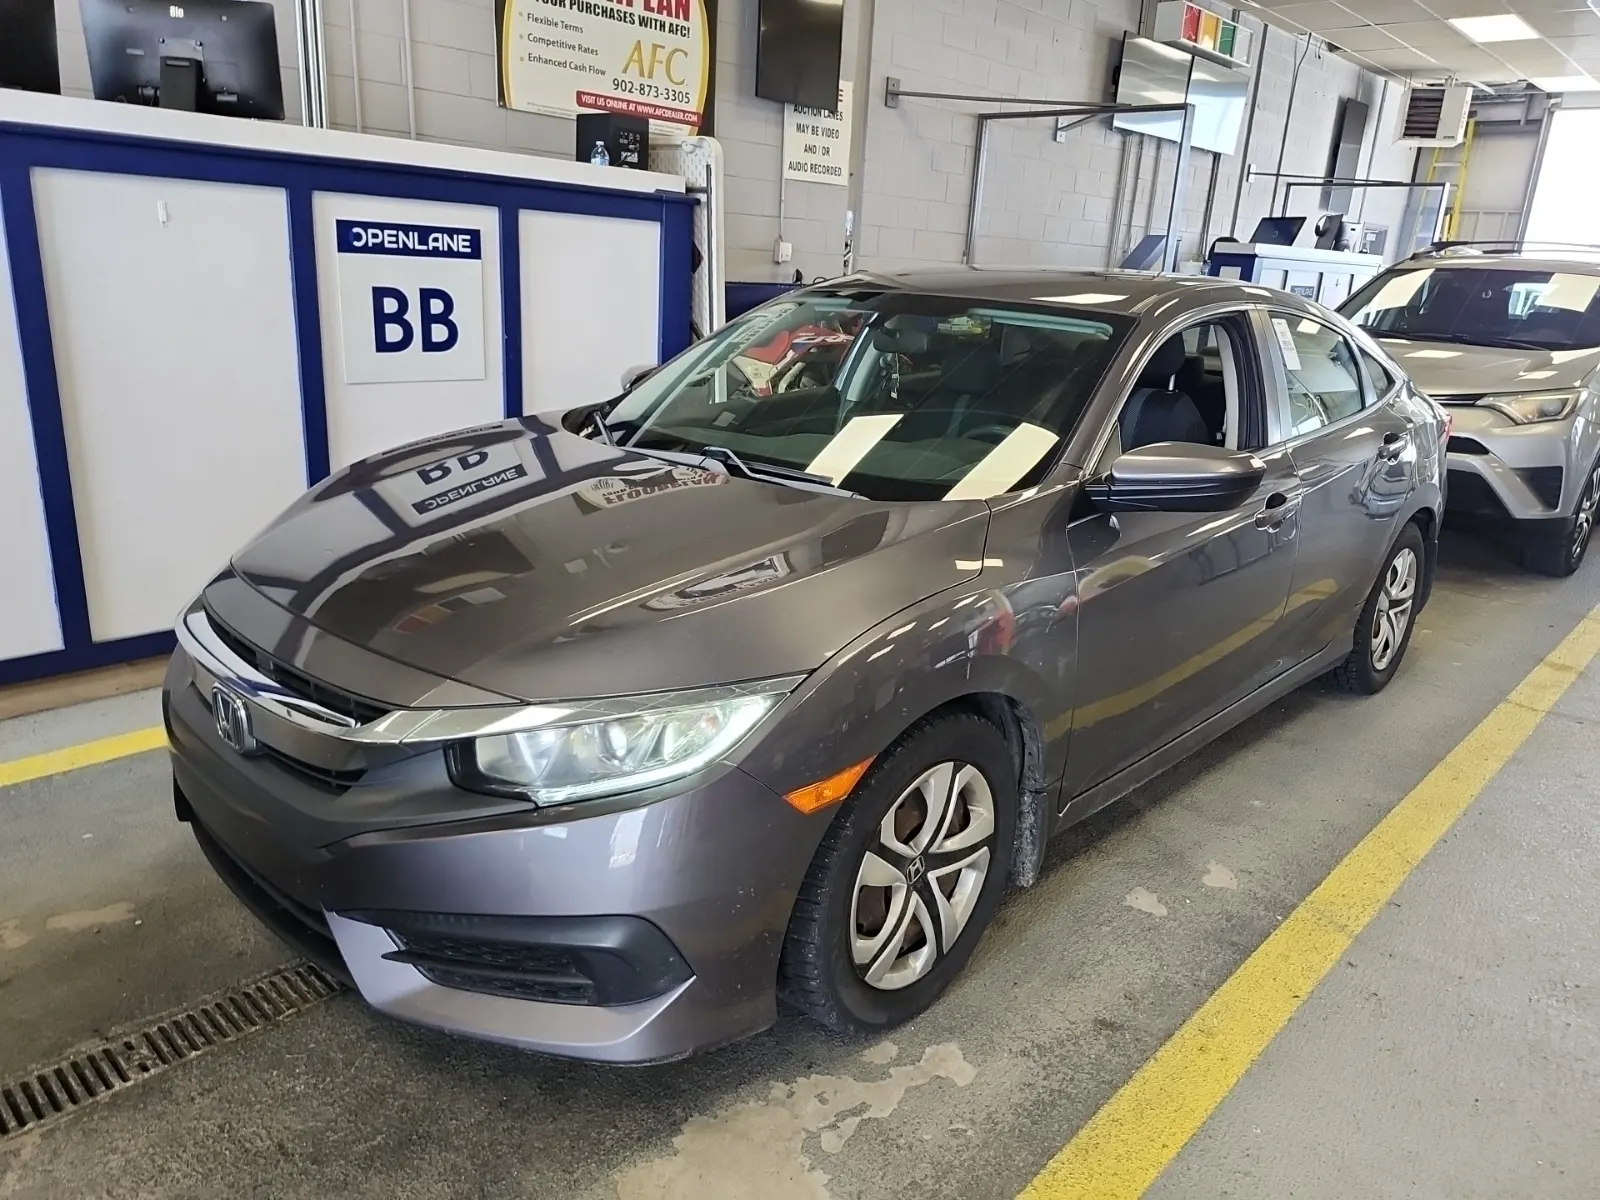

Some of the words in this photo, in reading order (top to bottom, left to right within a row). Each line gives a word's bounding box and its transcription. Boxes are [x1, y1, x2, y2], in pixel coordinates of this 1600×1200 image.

[527, 13, 559, 28] Flexible
[561, 20, 584, 34] Terms
[569, 0, 635, 25] PURCHASES
[638, 14, 666, 33] WITH
[668, 22, 690, 38] AFC!
[527, 34, 577, 51] Competitive
[578, 44, 599, 56] Rates
[528, 53, 567, 69] Enhanced
[569, 61, 587, 73] Cash
[588, 65, 607, 76] Flow
[621, 39, 689, 86] AFC
[612, 77, 691, 104] 902-873-3305
[581, 94, 596, 104] VISIT
[597, 96, 605, 106] US
[606, 98, 628, 111] ONLINE
[628, 102, 636, 111] AT
[636, 103, 698, 123] WWW.AFCDEALER.COM
[796, 123, 810, 135] MAY
[811, 125, 820, 136] BE
[821, 127, 840, 139] VIDEO
[803, 143, 817, 155] AND
[821, 146, 831, 157] OR
[788, 160, 809, 173] AUDIO
[351, 227, 472, 253] OPENLANE
[371, 285, 459, 353] BB
